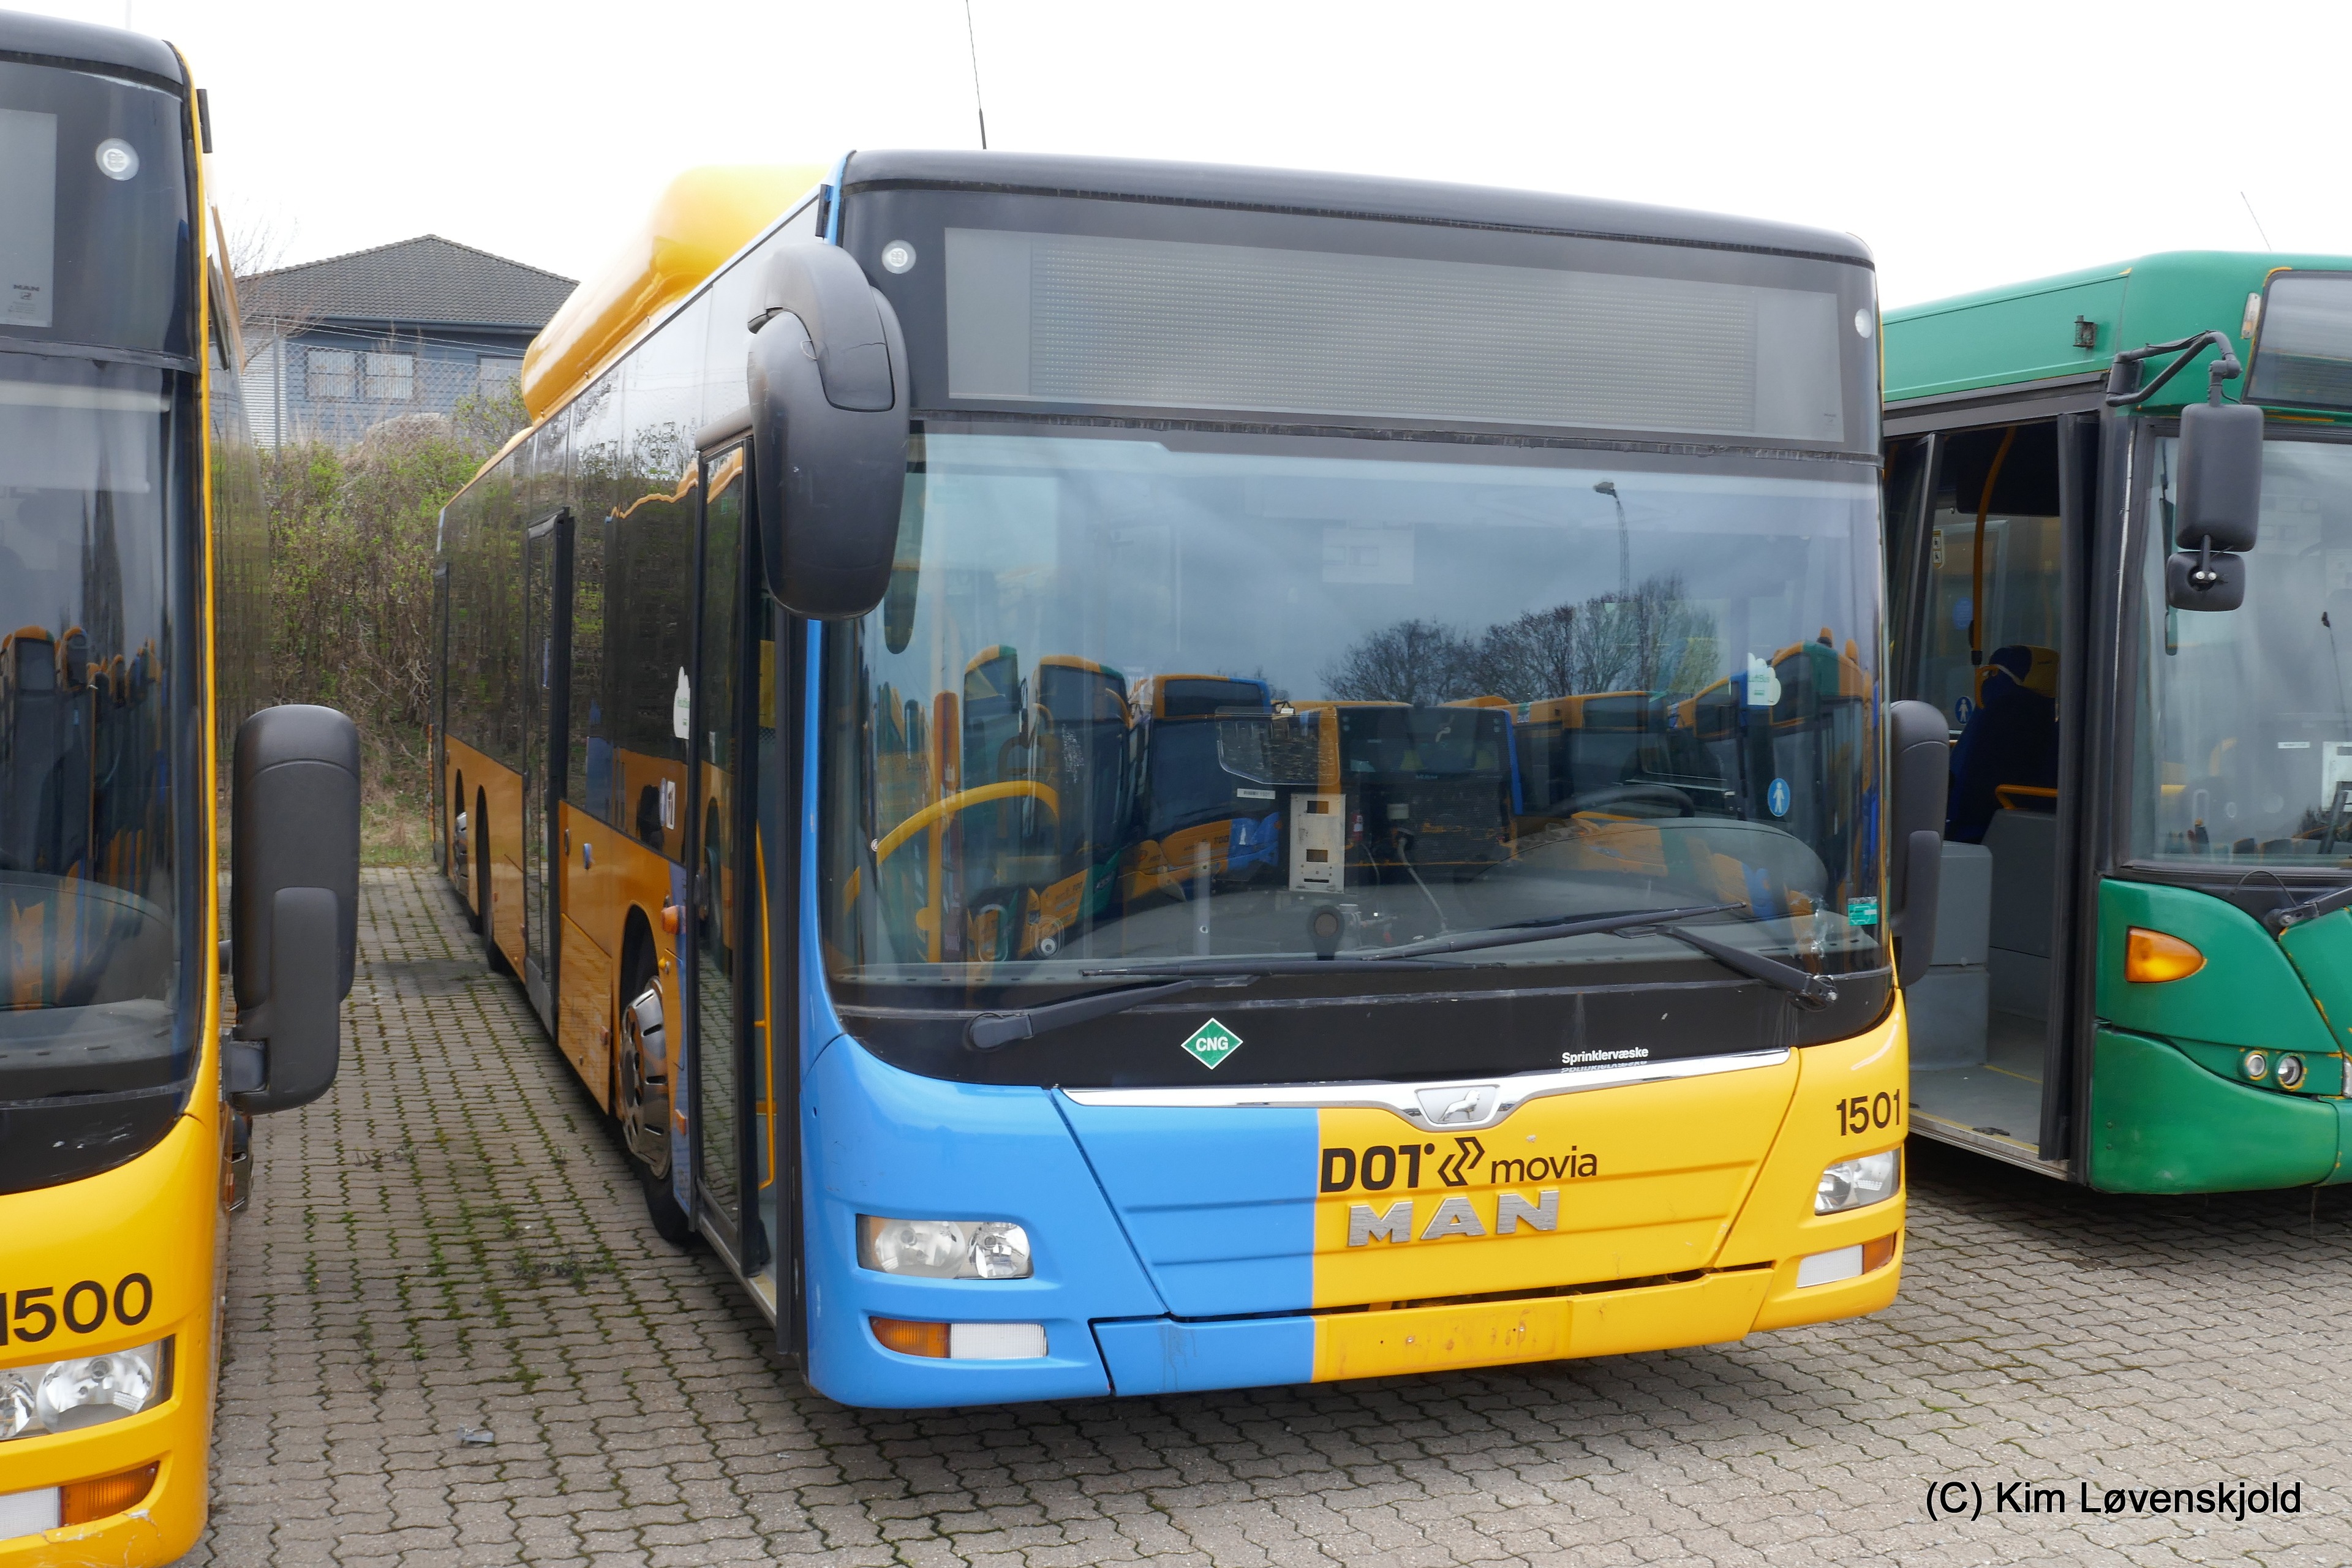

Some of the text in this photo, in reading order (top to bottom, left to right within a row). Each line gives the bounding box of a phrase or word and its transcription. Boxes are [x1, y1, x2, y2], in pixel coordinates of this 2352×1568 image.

[1196, 1036, 1229, 1052] CNG
[1562, 1047, 1649, 1066] Sprinklervæske
[1836, 1088, 1900, 1136] 1501
[1320, 1144, 1597, 1193] DOT movia
[1347, 1190, 1559, 1247] MAN
